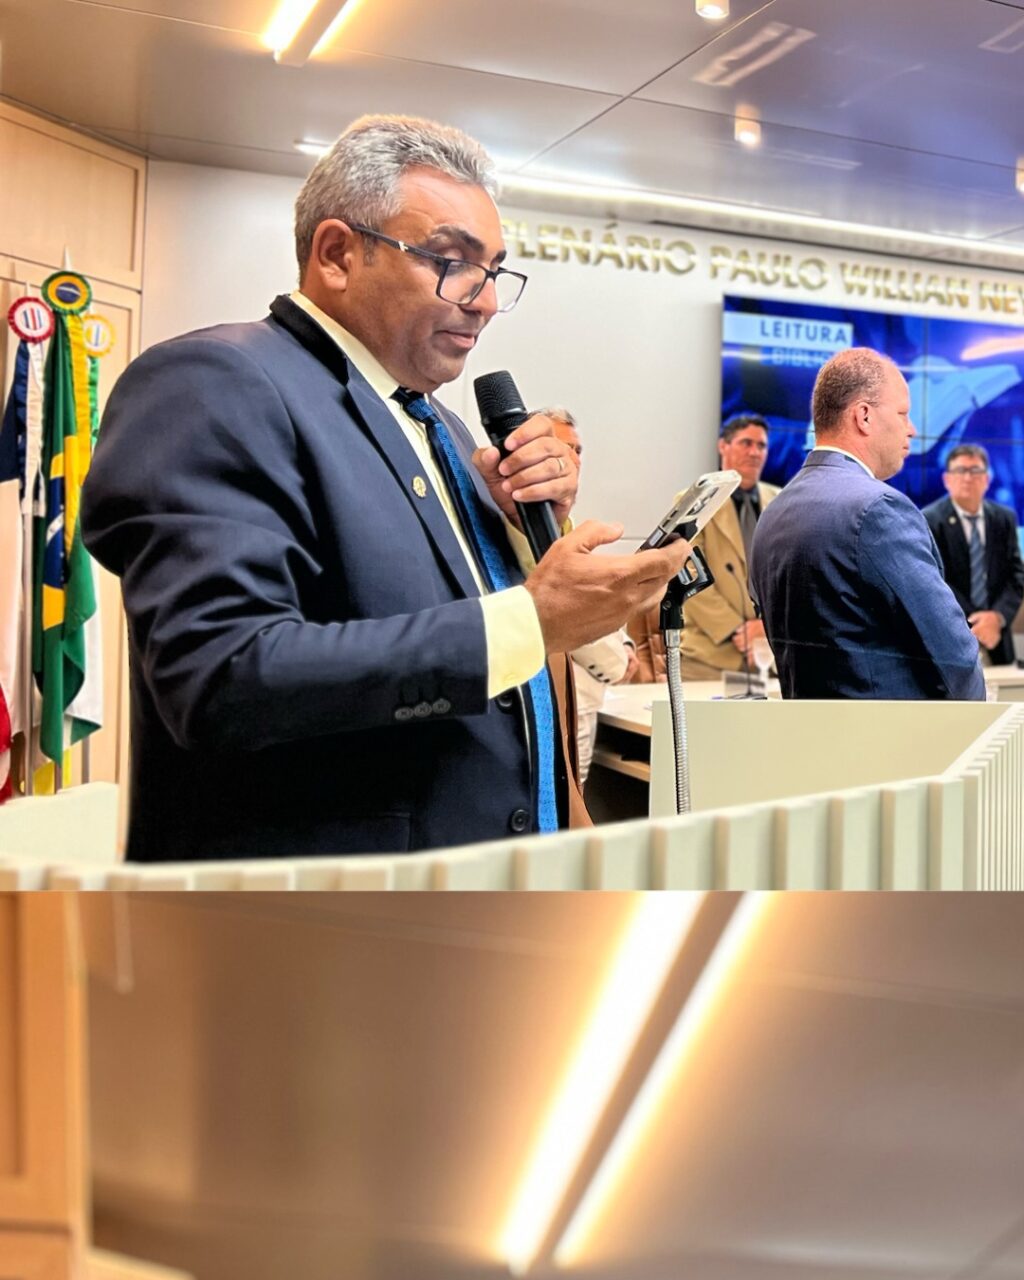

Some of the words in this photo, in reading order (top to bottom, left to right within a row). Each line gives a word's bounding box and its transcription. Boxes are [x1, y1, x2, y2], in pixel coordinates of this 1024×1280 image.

[709, 244, 829, 291] PAULO
[839, 261, 971, 309] WILLIAN
[760, 320, 848, 344] LEITURA
